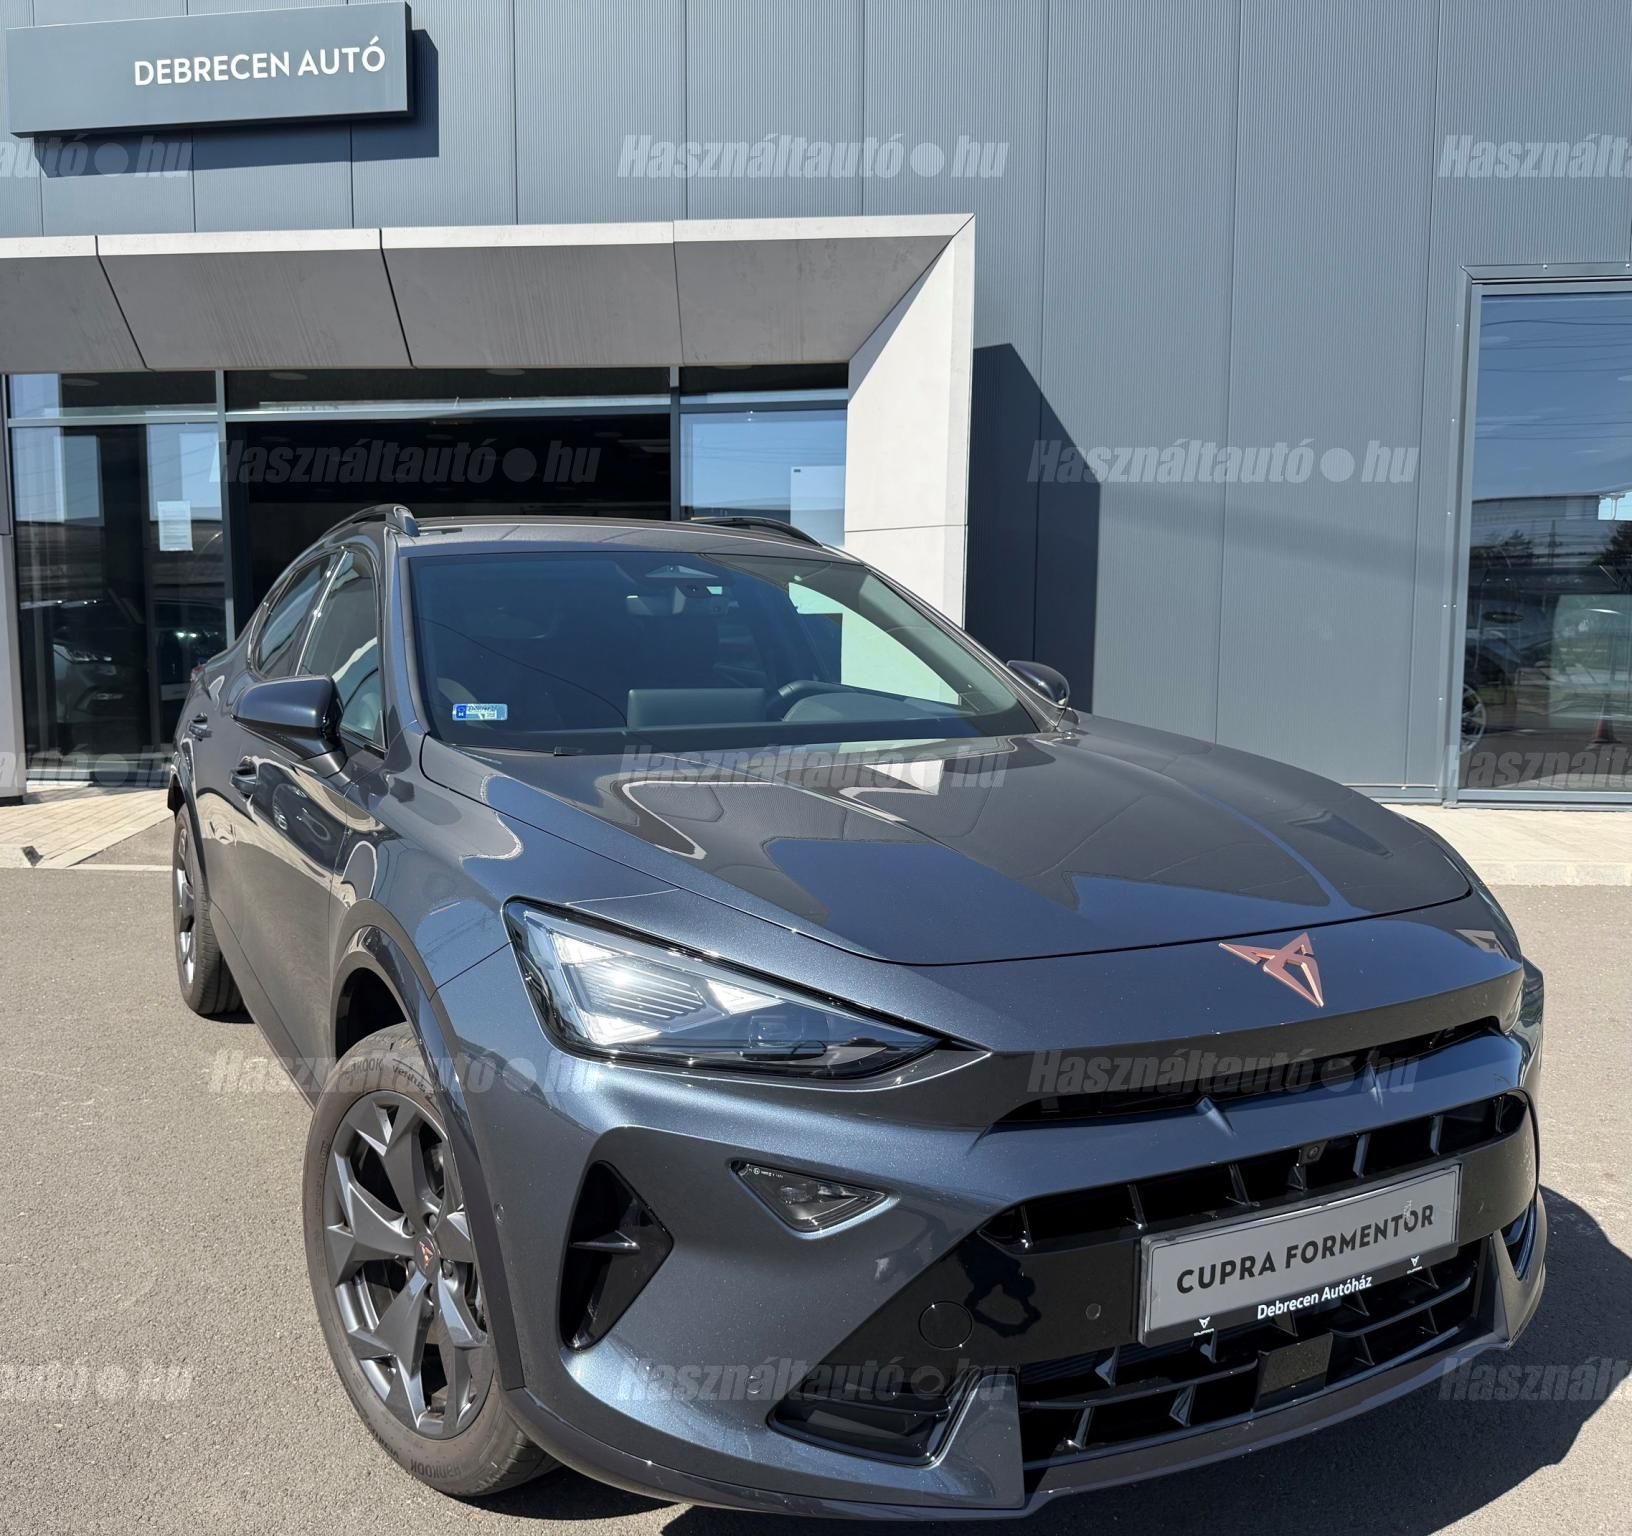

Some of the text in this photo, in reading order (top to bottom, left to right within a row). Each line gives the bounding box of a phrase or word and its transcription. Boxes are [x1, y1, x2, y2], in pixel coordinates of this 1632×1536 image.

[134, 35, 386, 86] DEBRECEN AUTÓ
[1177, 1205, 1434, 1294] CUPRA FORMENTOR
[1257, 1274, 1372, 1320] Debrecen Autóház
